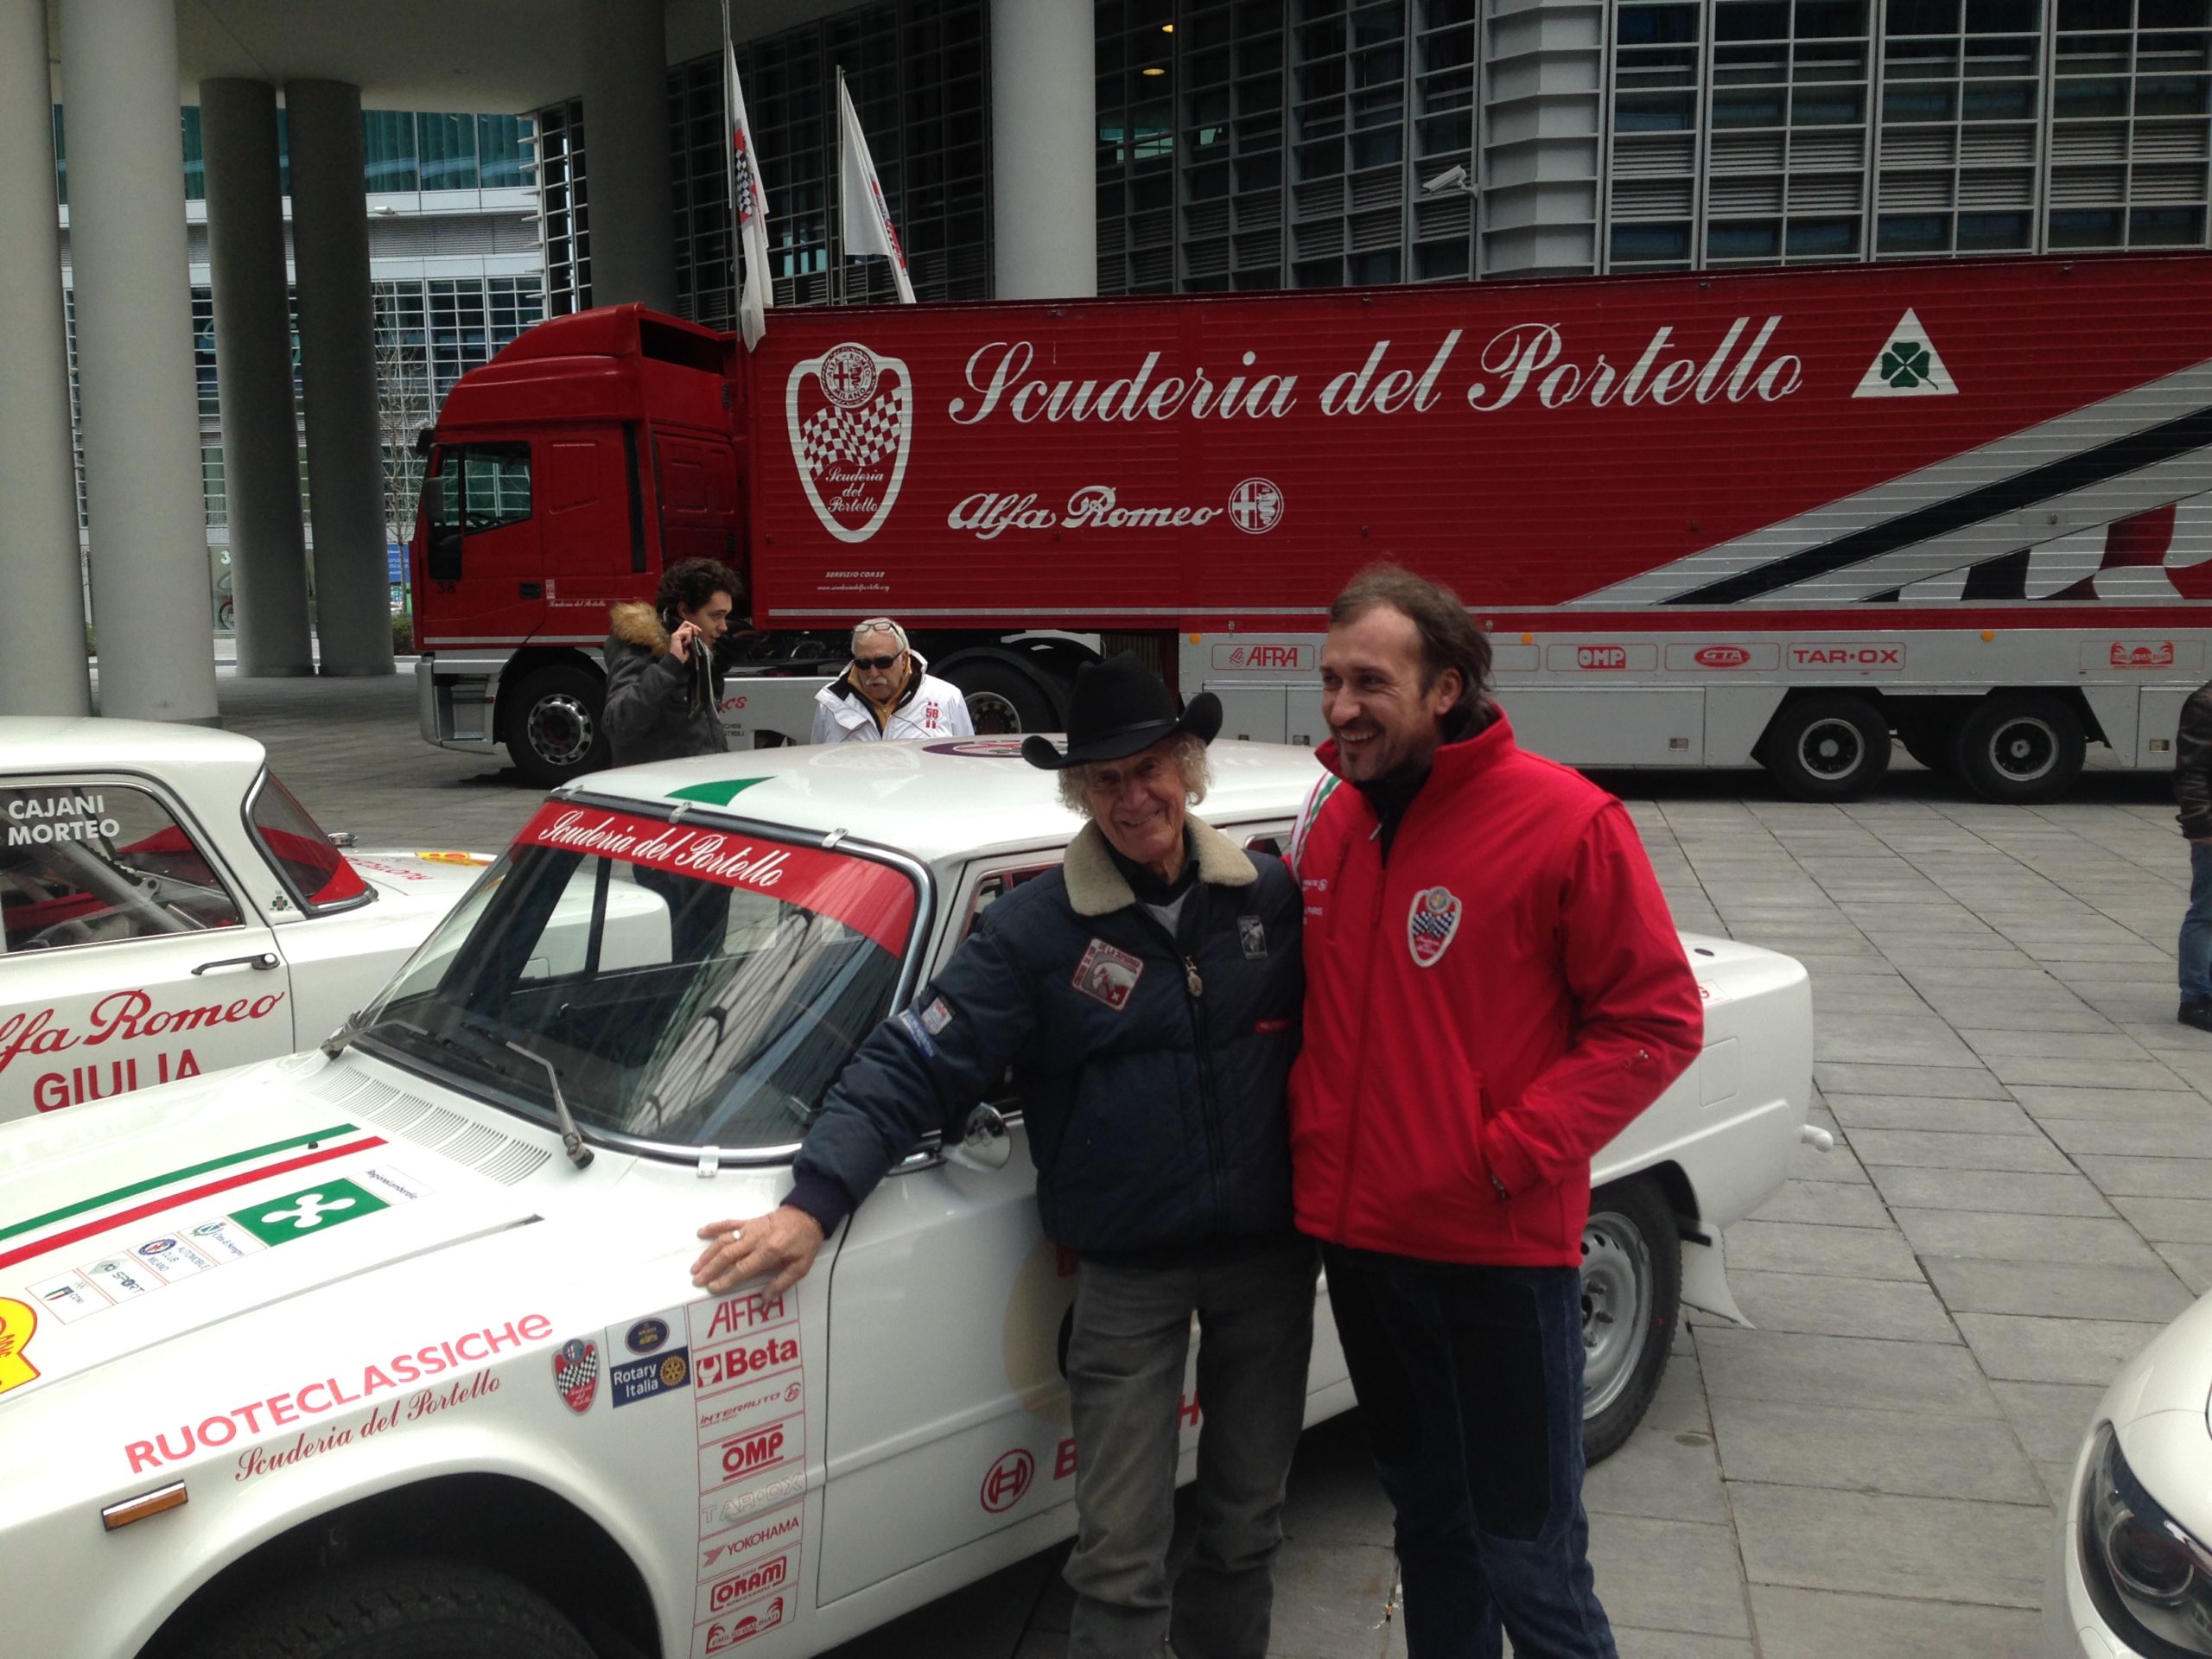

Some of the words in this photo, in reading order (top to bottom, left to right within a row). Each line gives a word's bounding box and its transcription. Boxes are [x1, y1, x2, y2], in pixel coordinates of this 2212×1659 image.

[949, 341, 1298, 424] Scuderia
[1319, 329, 1463, 416] del
[1467, 315, 1802, 412] Portello
[833, 387, 866, 400] MILANO
[826, 467, 884, 483] Scuderia
[842, 482, 865, 498] del
[828, 496, 879, 513] Portello
[948, 493, 1057, 541] Alfa
[1061, 485, 1223, 529] Romeo
[1246, 646, 1298, 667] AFRA
[1579, 649, 1624, 667] OMP
[8, 795, 105, 820] CAJANI
[8, 818, 120, 846] MORTEO
[538, 810, 635, 853] Scuderia
[630, 827, 696, 862] del
[675, 835, 791, 888] Portello
[0, 1007, 82, 1074] lfa
[82, 988, 285, 1046] Romeo
[707, 1292, 785, 1340] AFRA
[613, 1363, 658, 1386] Rotary
[725, 1338, 798, 1380] Beta
[626, 1379, 658, 1398] Italia
[234, 1422, 353, 1482] Scuderia
[361, 1405, 400, 1438] del
[407, 1369, 501, 1421] Portello
[722, 1431, 784, 1472] OMP
[728, 1516, 799, 1555] YOKOHAMA
[716, 1564, 781, 1604] ORAM
